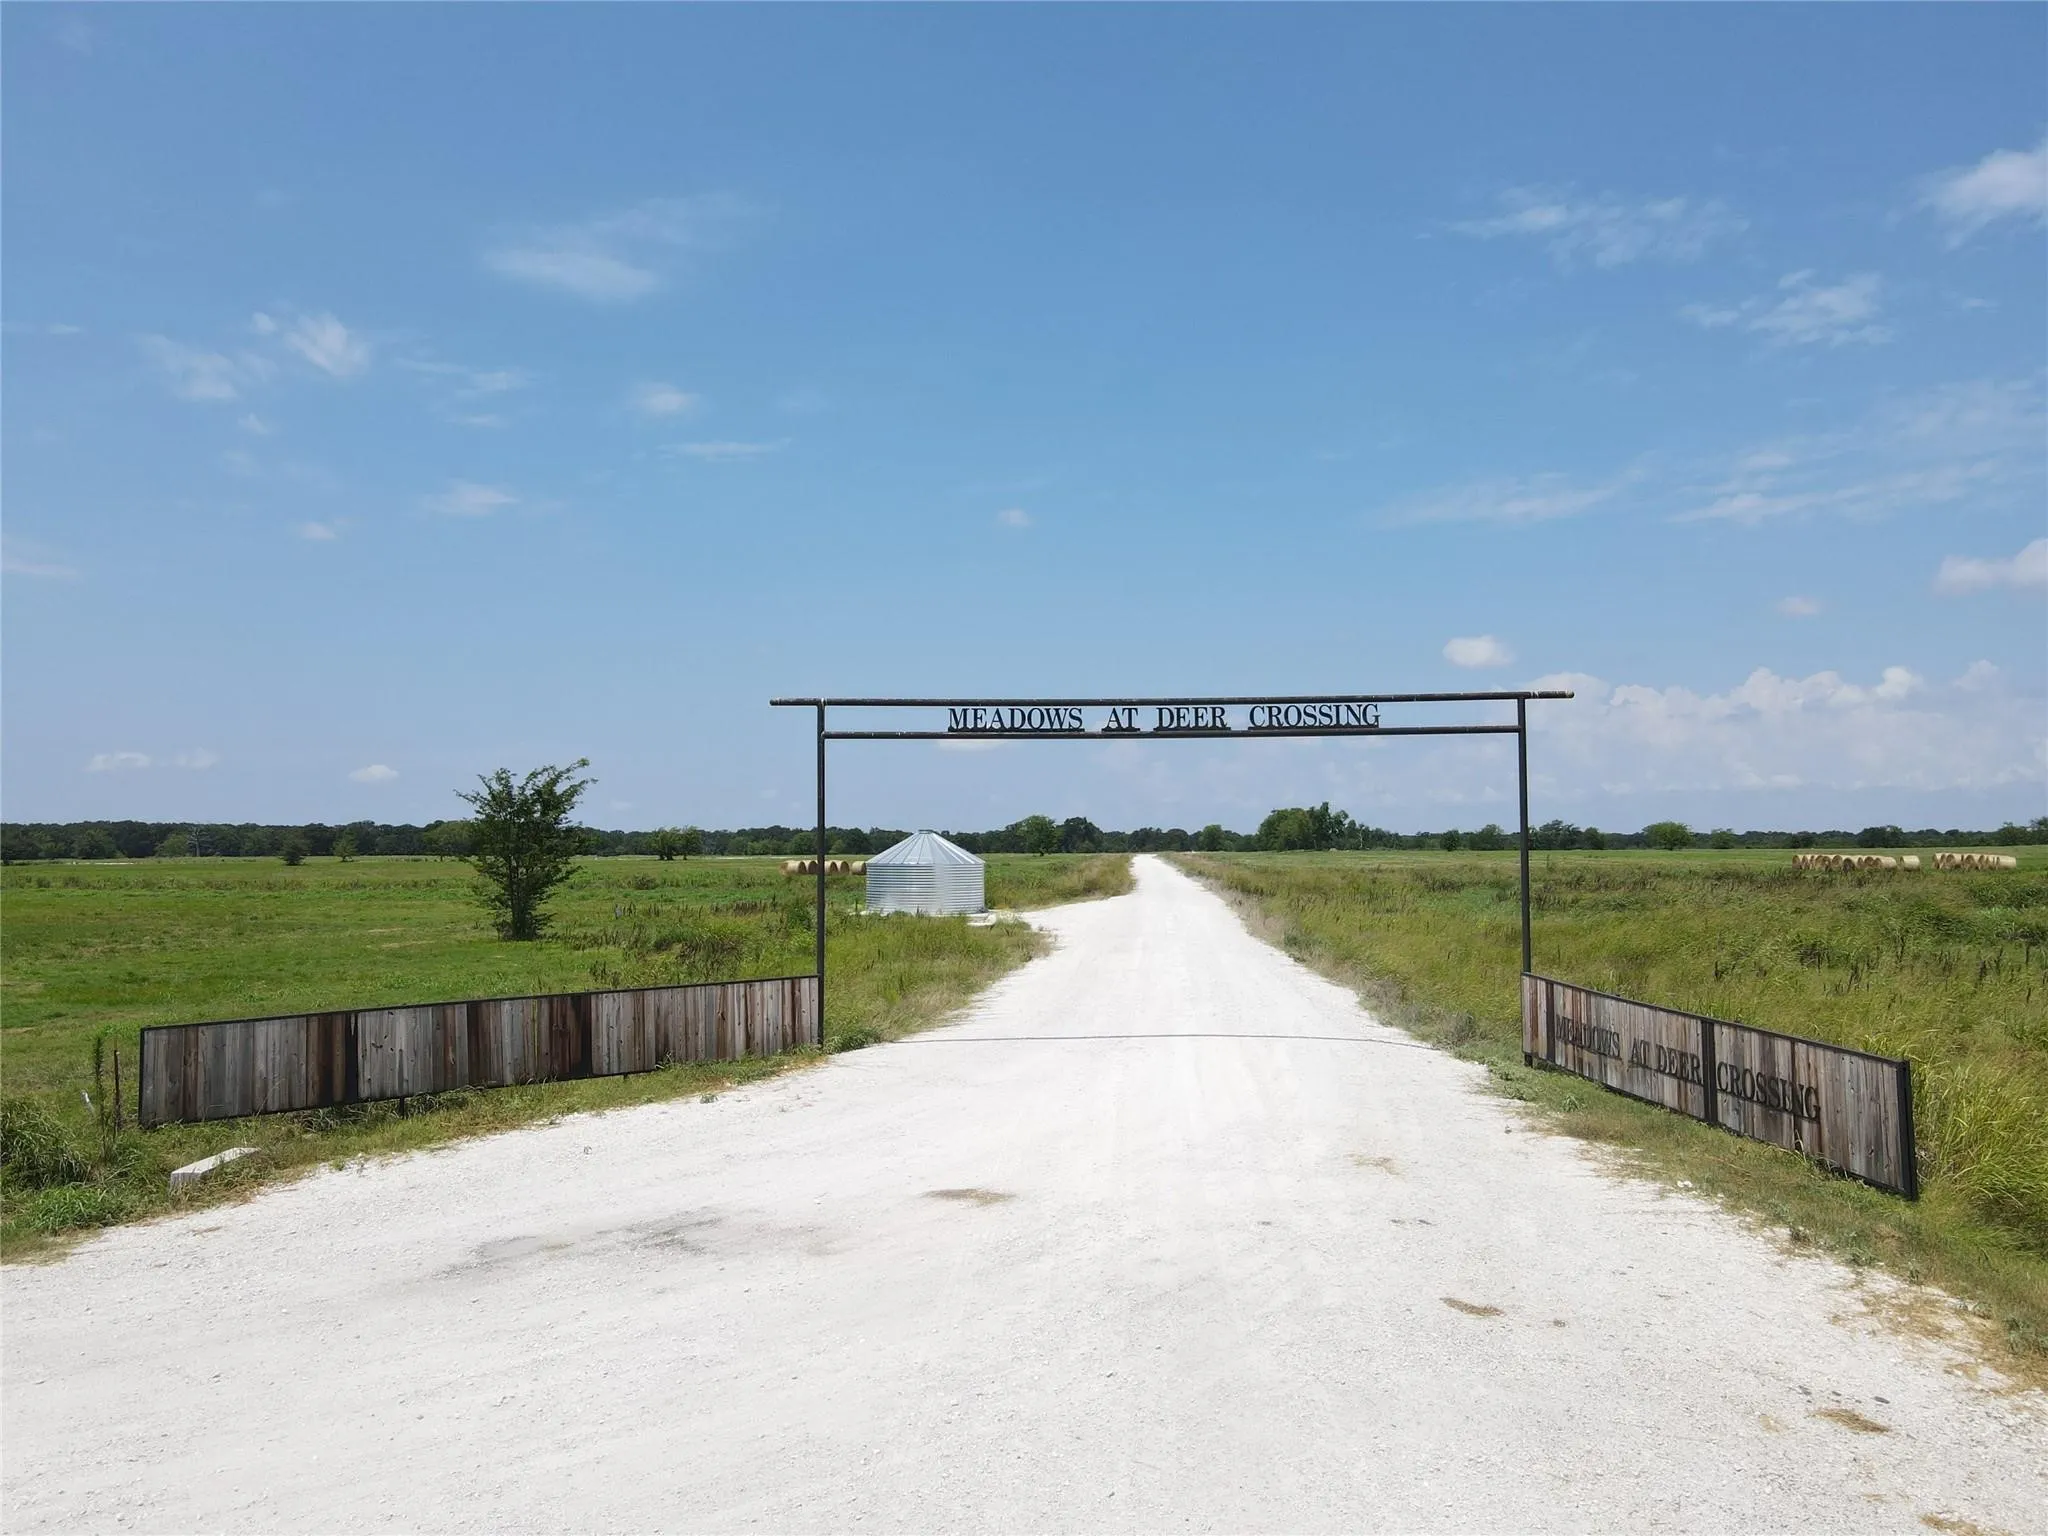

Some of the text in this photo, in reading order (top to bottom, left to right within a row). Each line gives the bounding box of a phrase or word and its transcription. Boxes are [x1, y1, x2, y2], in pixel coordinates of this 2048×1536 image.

[947, 703, 1380, 732] MEADOWS AT DEER CROSSING
[1628, 1036, 1653, 1069] AT
[1656, 1043, 1704, 1086] DEER
[1717, 1060, 1821, 1123] CROSSING
